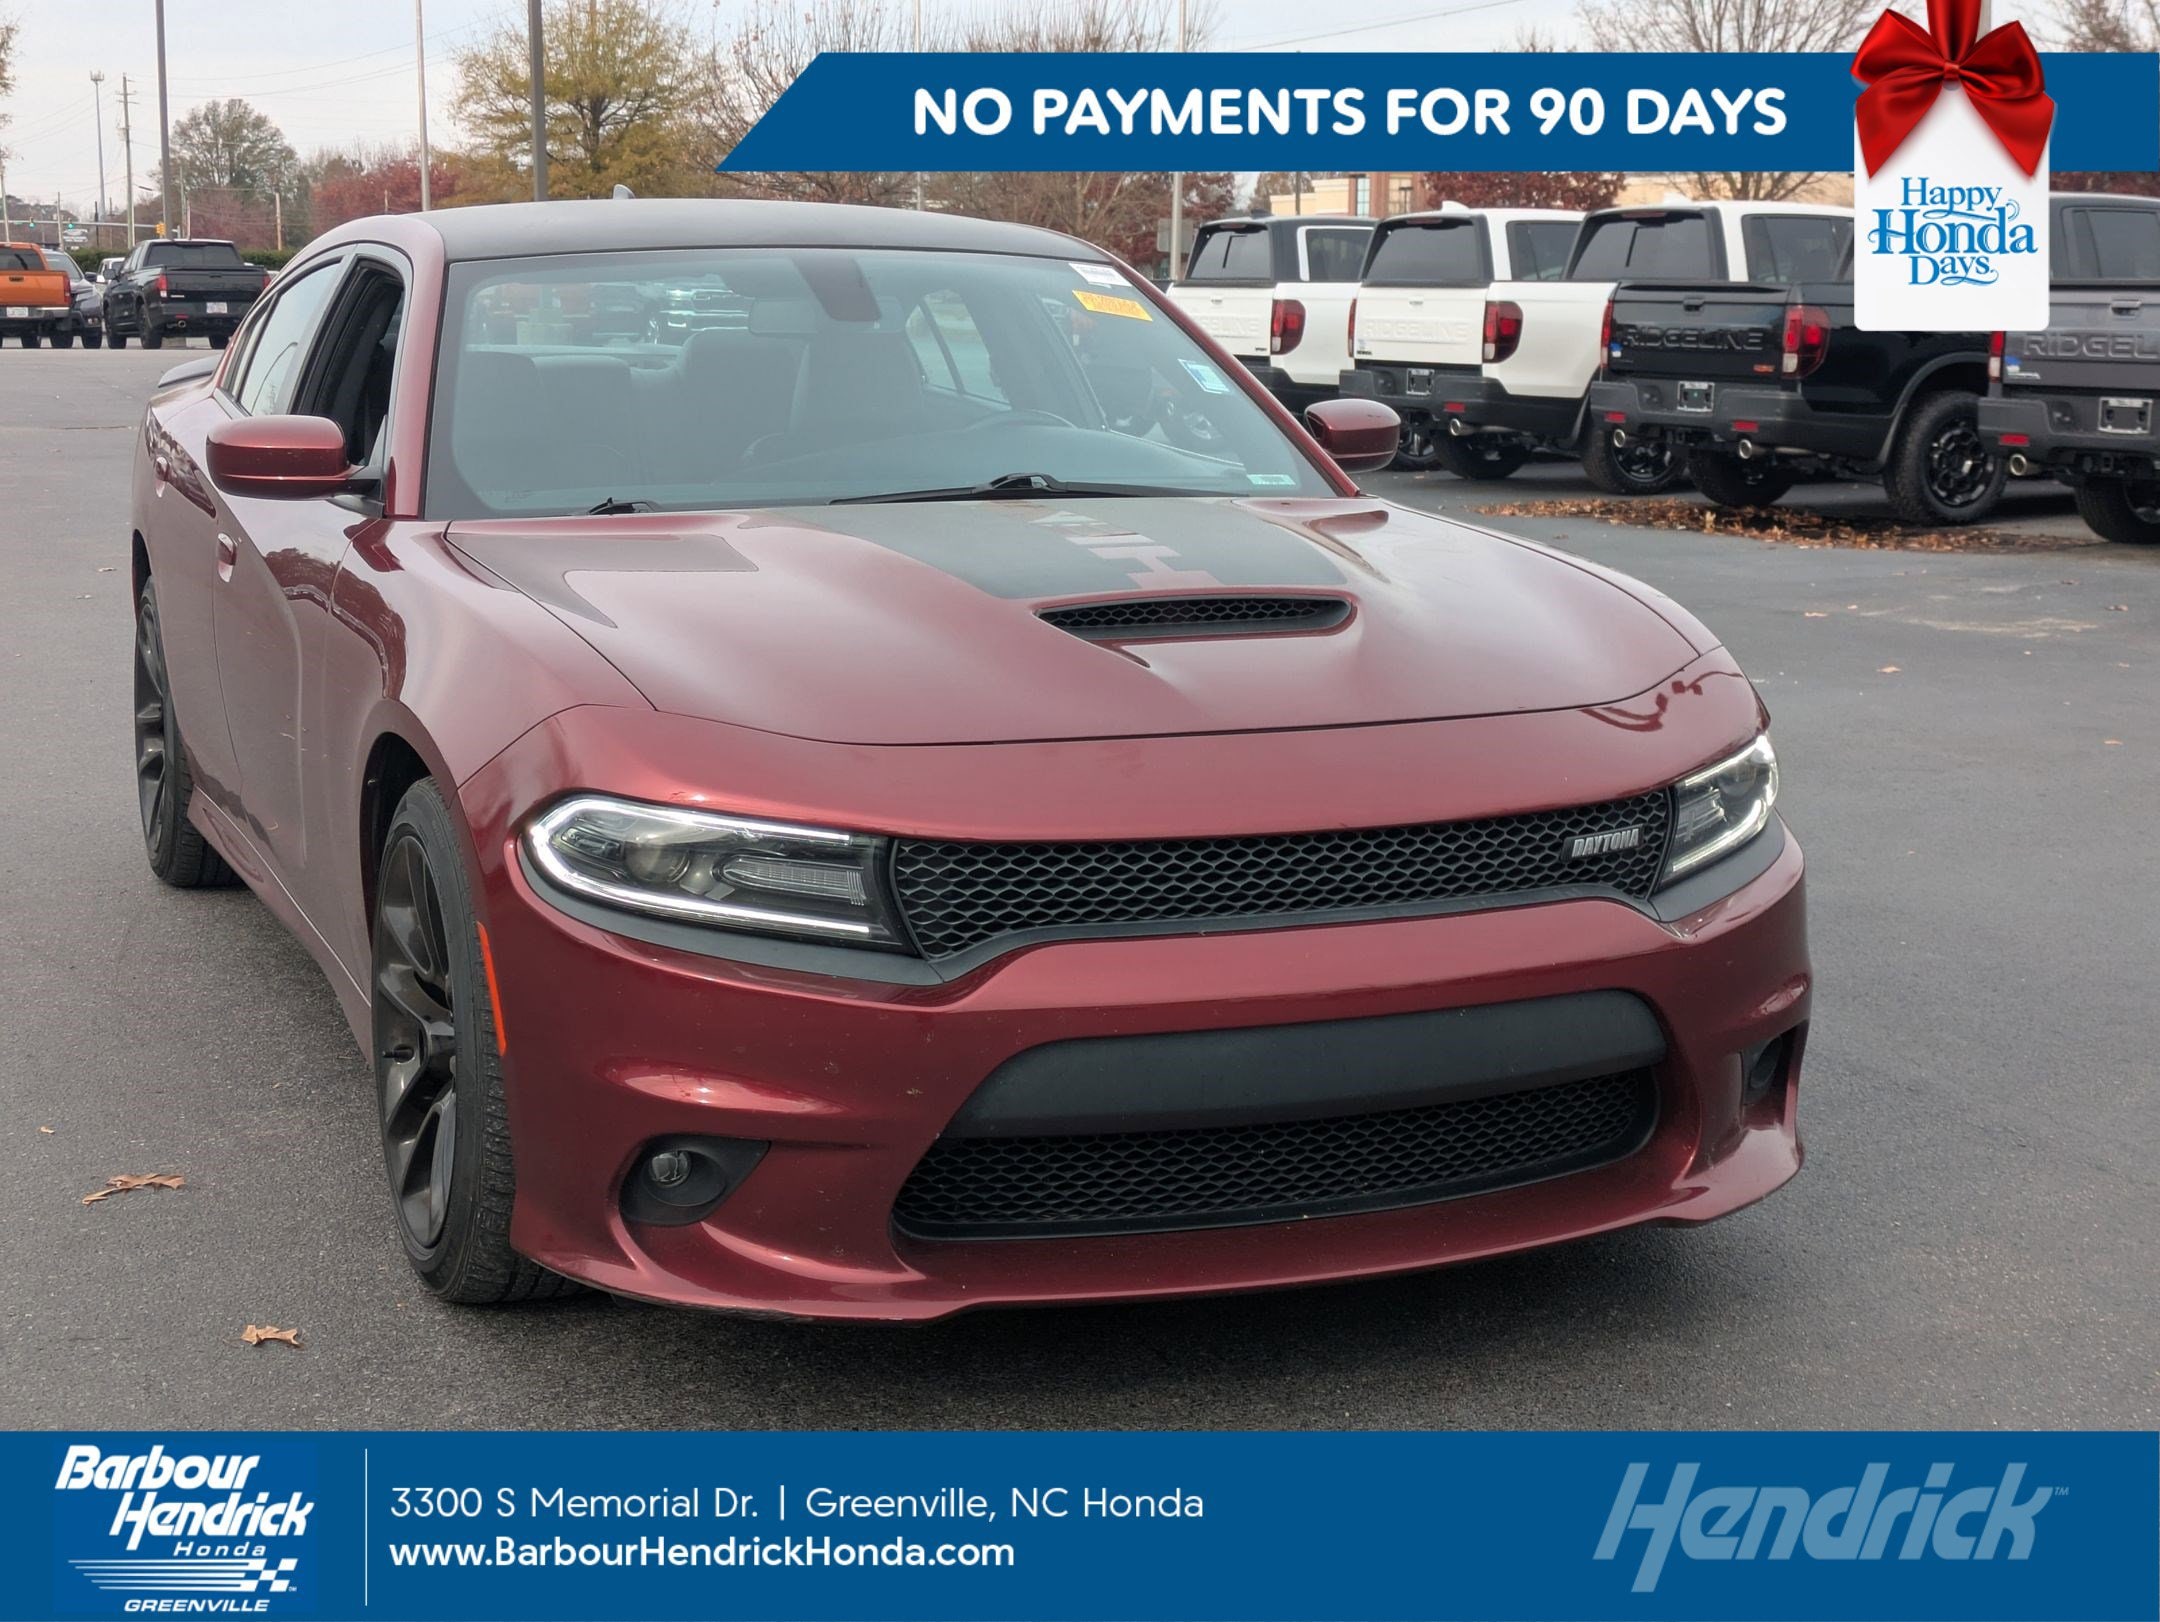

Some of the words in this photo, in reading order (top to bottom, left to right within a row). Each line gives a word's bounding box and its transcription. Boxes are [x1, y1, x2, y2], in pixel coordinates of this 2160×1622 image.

[1363, 319, 1472, 341] RIDGELINE
[1622, 325, 1765, 351] RIDGELINE
[2023, 332, 2159, 359] RIDGEL
[1571, 828, 1639, 858] DAYTONA
